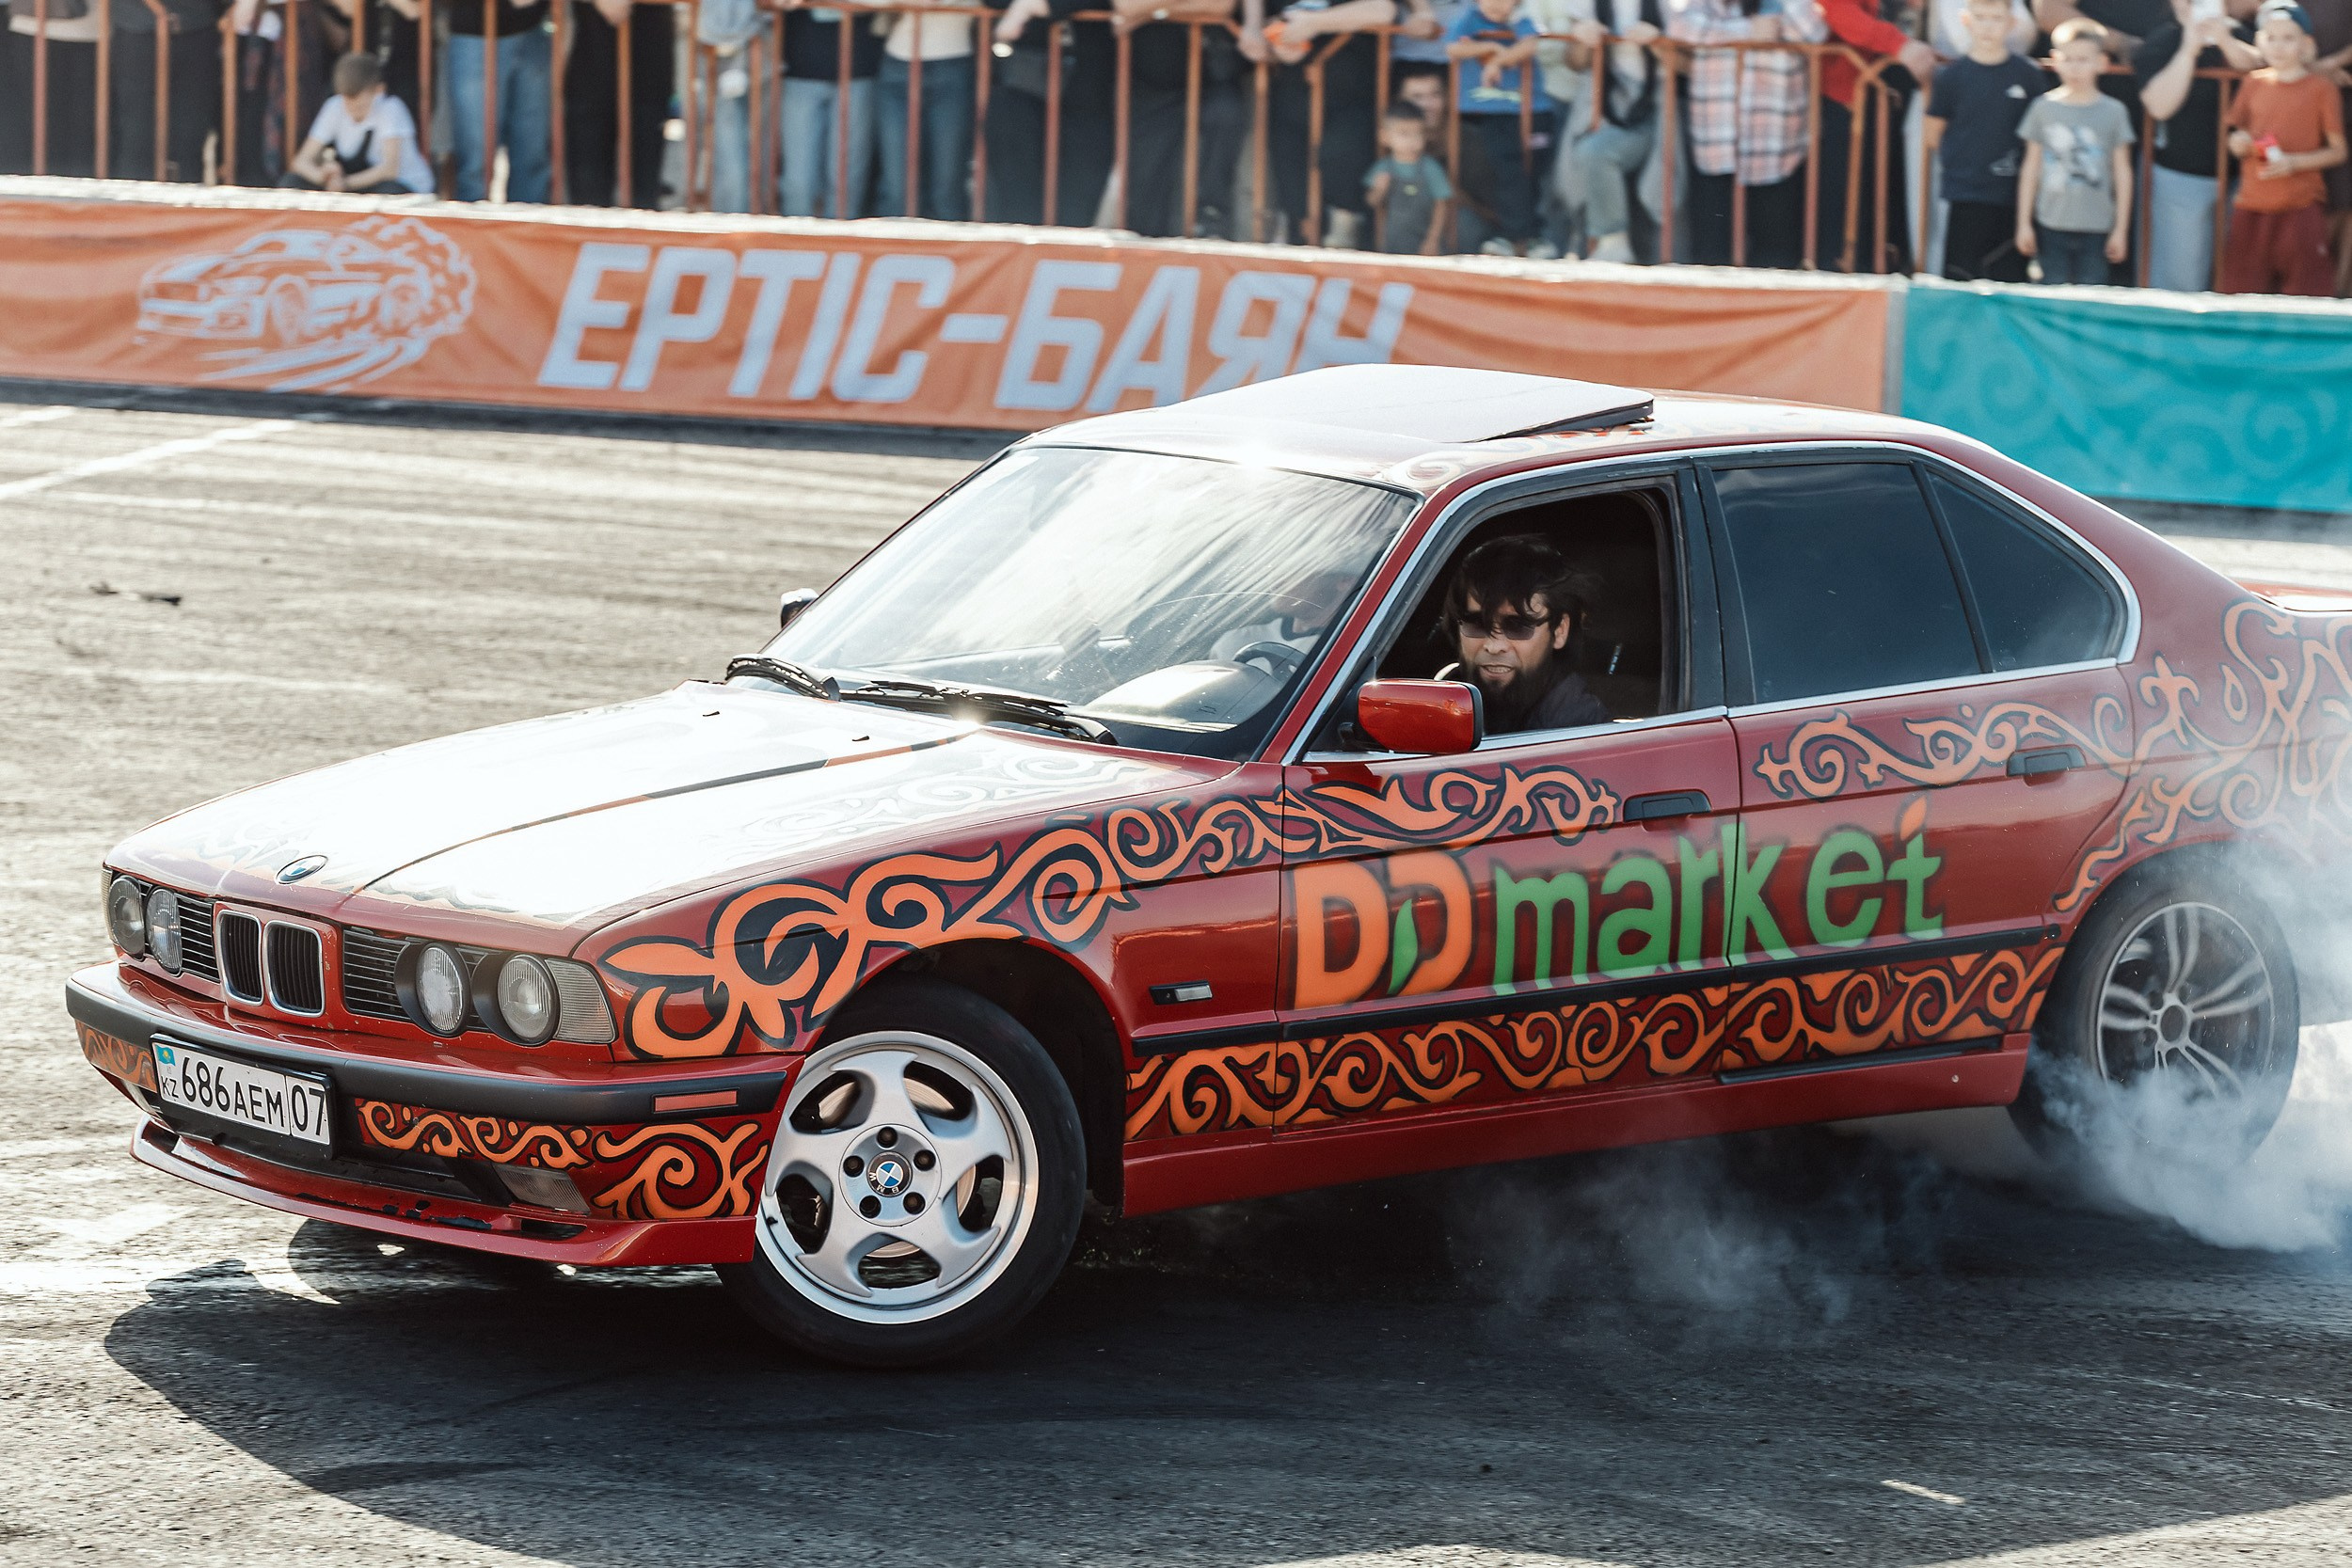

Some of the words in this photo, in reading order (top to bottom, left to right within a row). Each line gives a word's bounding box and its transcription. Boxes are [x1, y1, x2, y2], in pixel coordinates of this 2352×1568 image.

[537, 242, 1414, 412] ЕРТІС-БАЯН
[1492, 796, 1945, 997] market
[160, 1075, 179, 1099] KZ
[291, 1084, 326, 1136] 07
